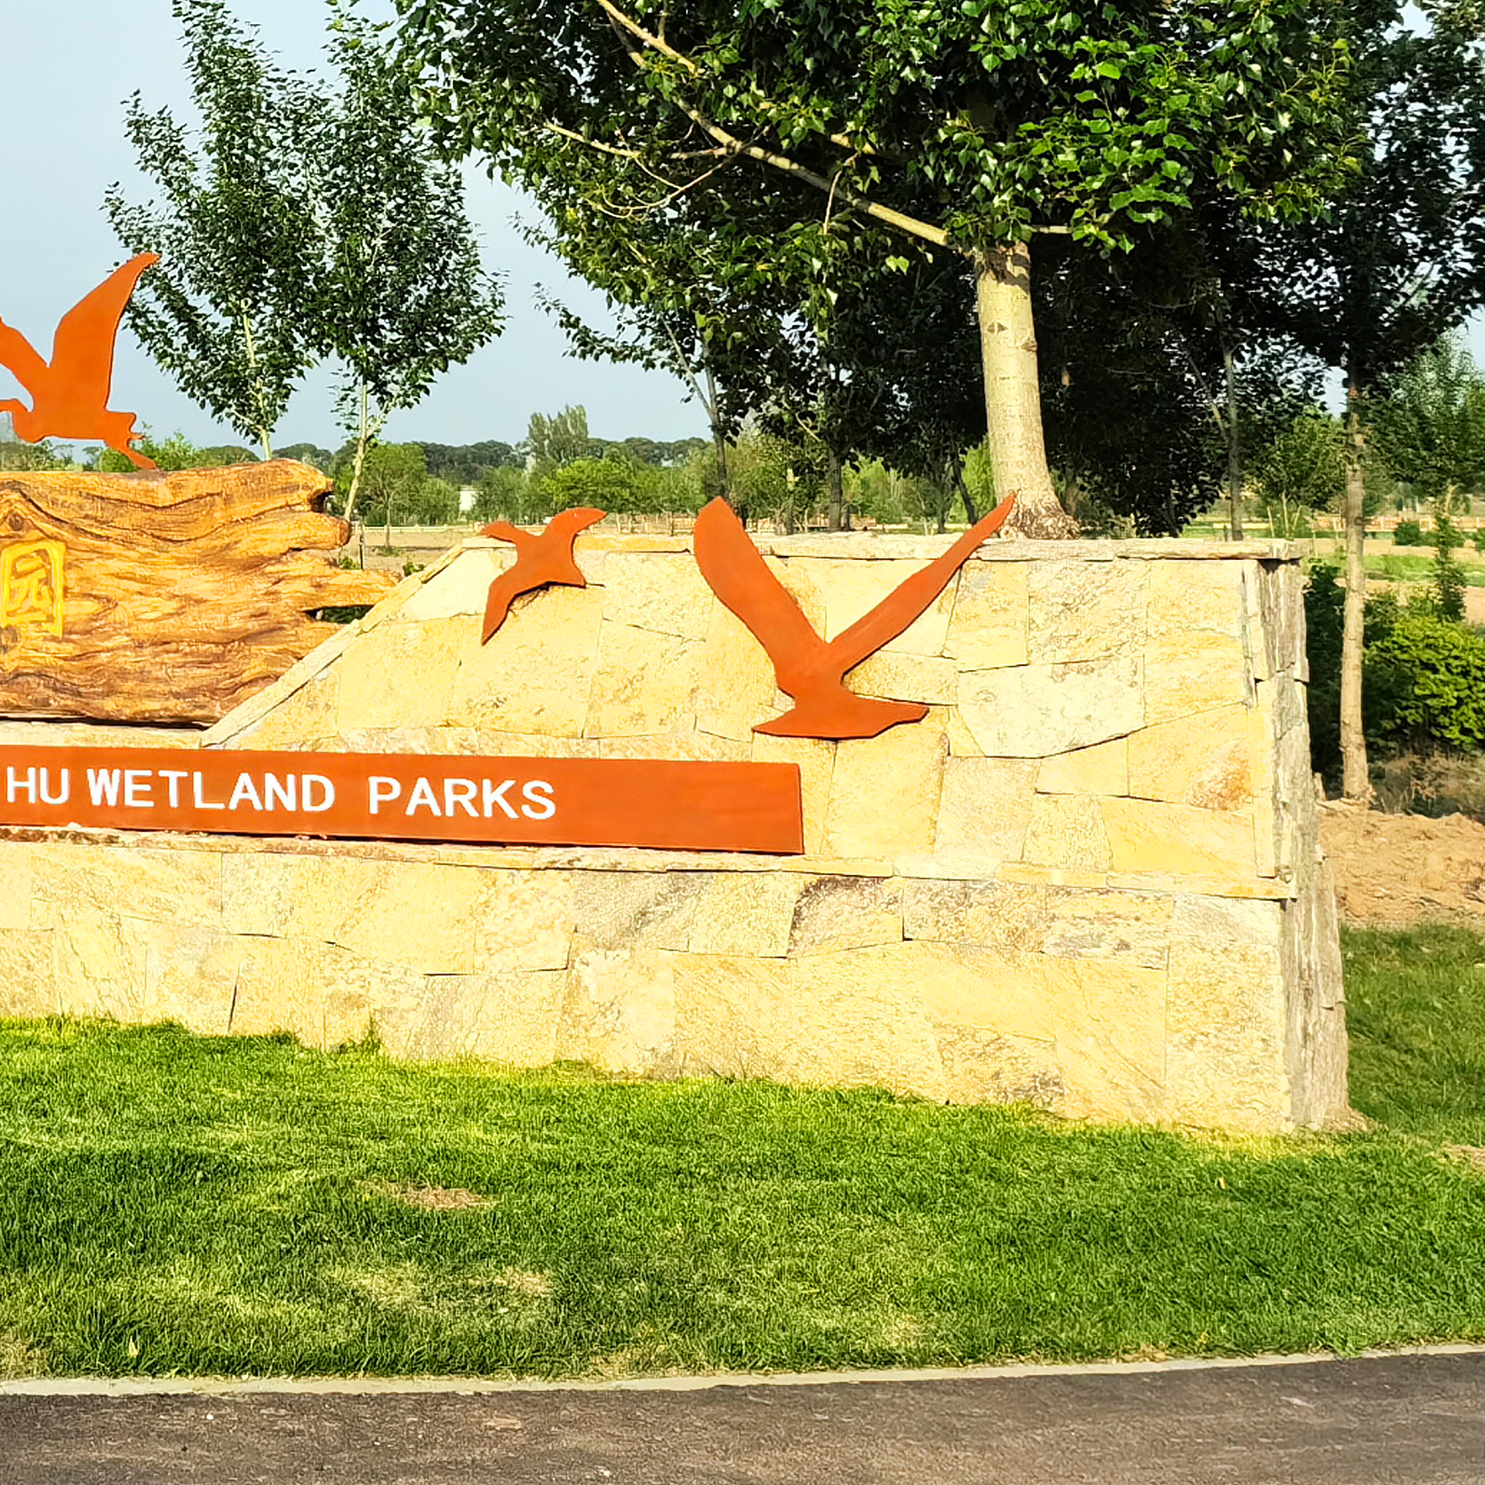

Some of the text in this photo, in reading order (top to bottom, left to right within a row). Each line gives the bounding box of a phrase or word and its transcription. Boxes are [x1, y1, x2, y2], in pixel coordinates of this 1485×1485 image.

[5, 766, 71, 806] HU
[86, 768, 337, 814] WETLAND
[368, 775, 558, 821] PARKS
